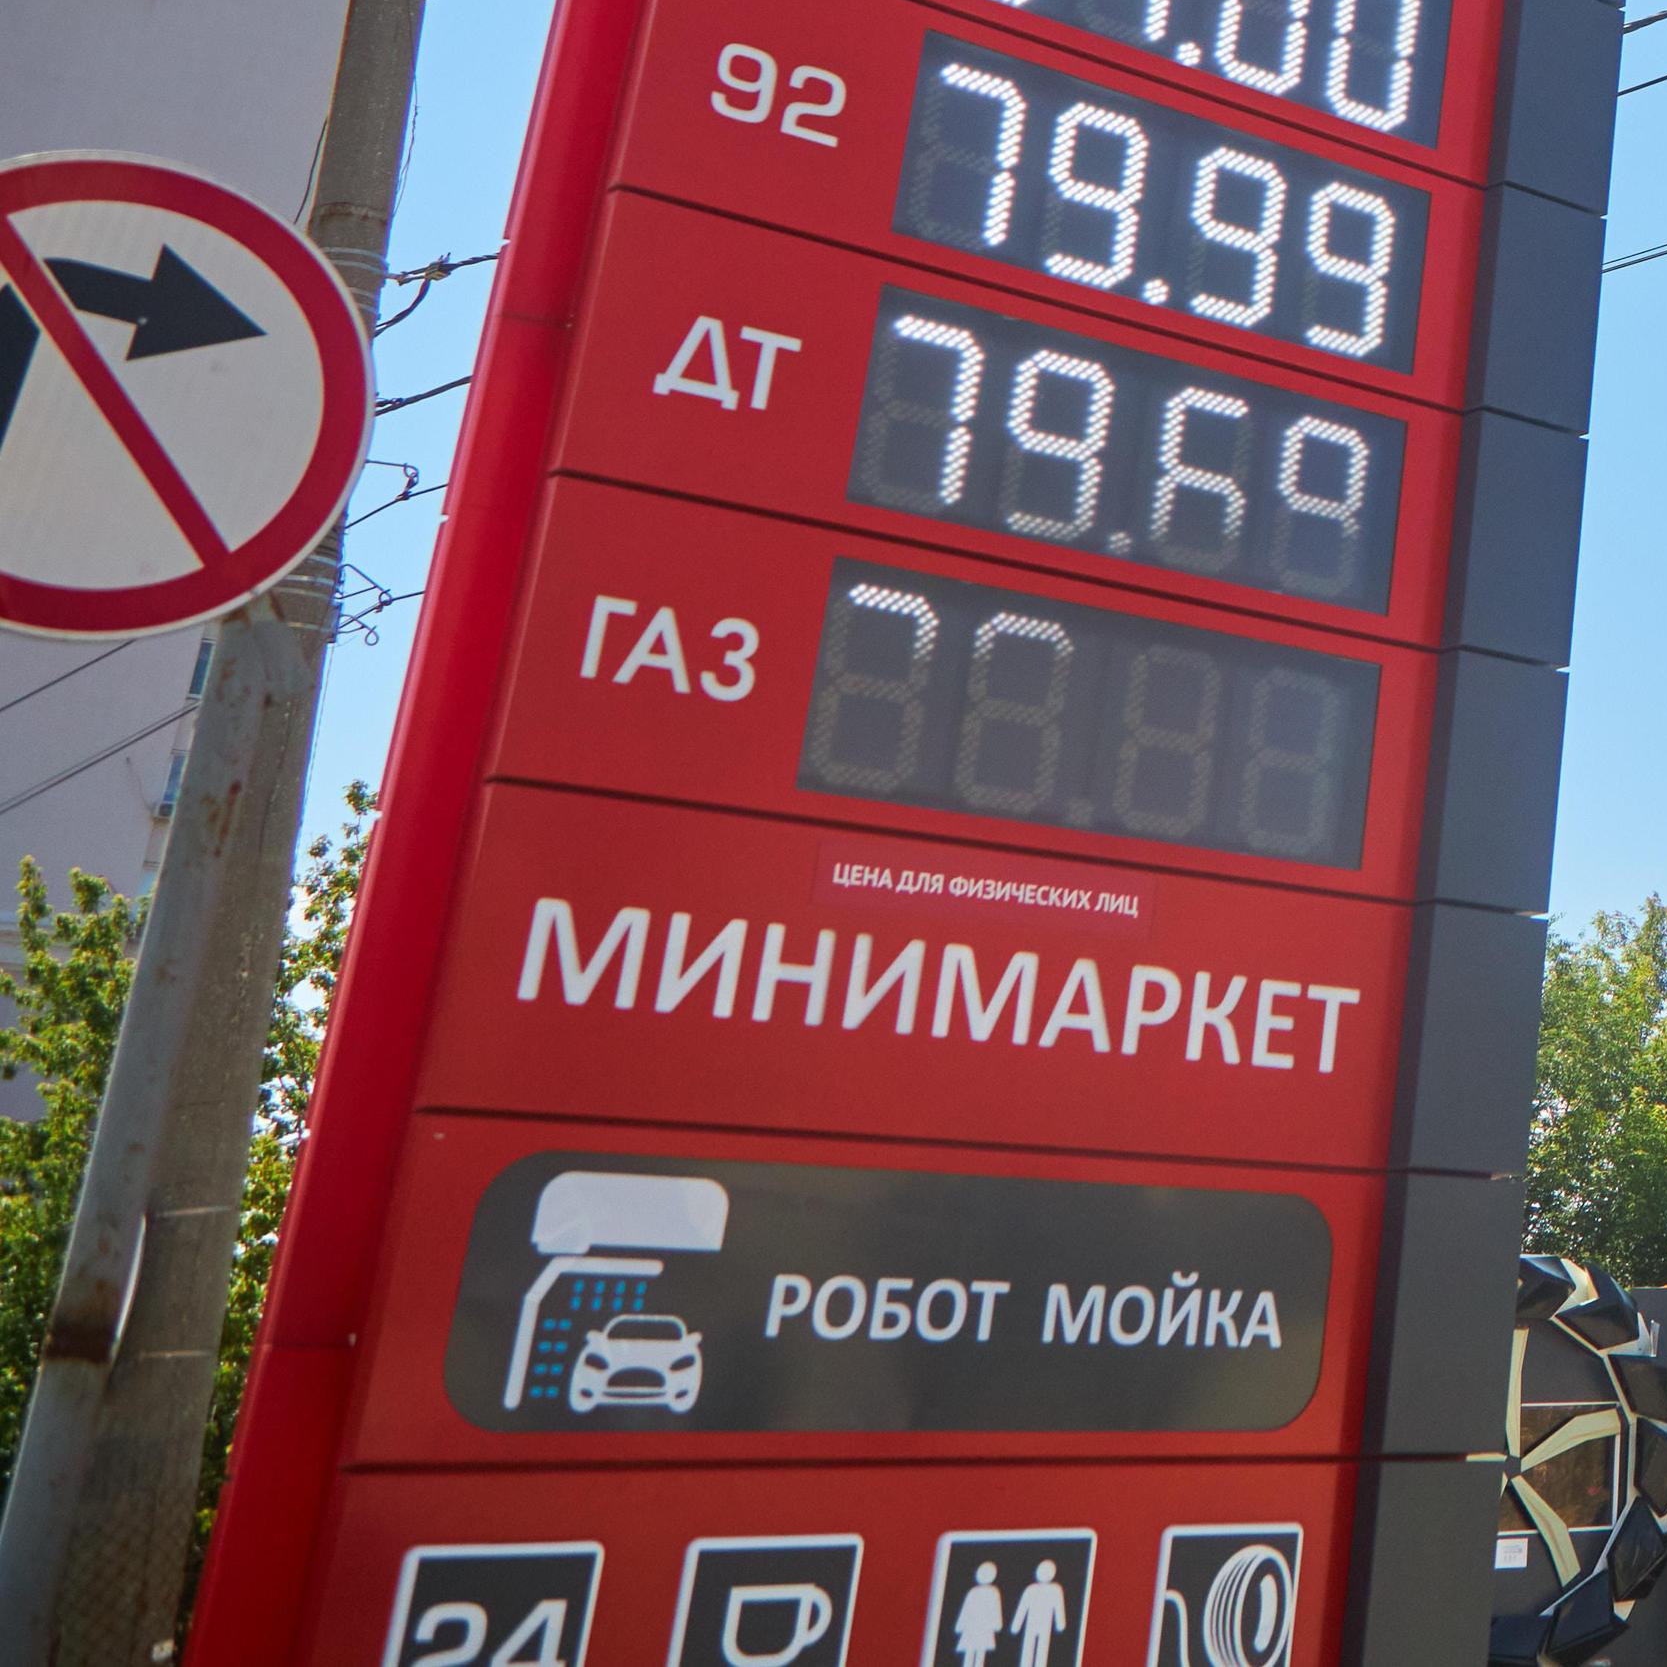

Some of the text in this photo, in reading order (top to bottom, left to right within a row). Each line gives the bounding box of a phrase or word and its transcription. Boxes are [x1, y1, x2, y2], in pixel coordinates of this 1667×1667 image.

[709, 42, 849, 149] 92
[938, 59, 1397, 360] 79.99
[651, 313, 804, 413] ДТ
[890, 311, 1370, 596] 79.69
[578, 591, 762, 704] ГАЗ
[832, 862, 1139, 919] ЦЕНА ДЛЯ ФИЗИЧЕСКИХ ЛИЦ
[515, 896, 1361, 1075] МИНИМАРКЕТ
[764, 1271, 1283, 1350] РОБОТ МОЙКА
[410, 1598, 568, 1667] 24
